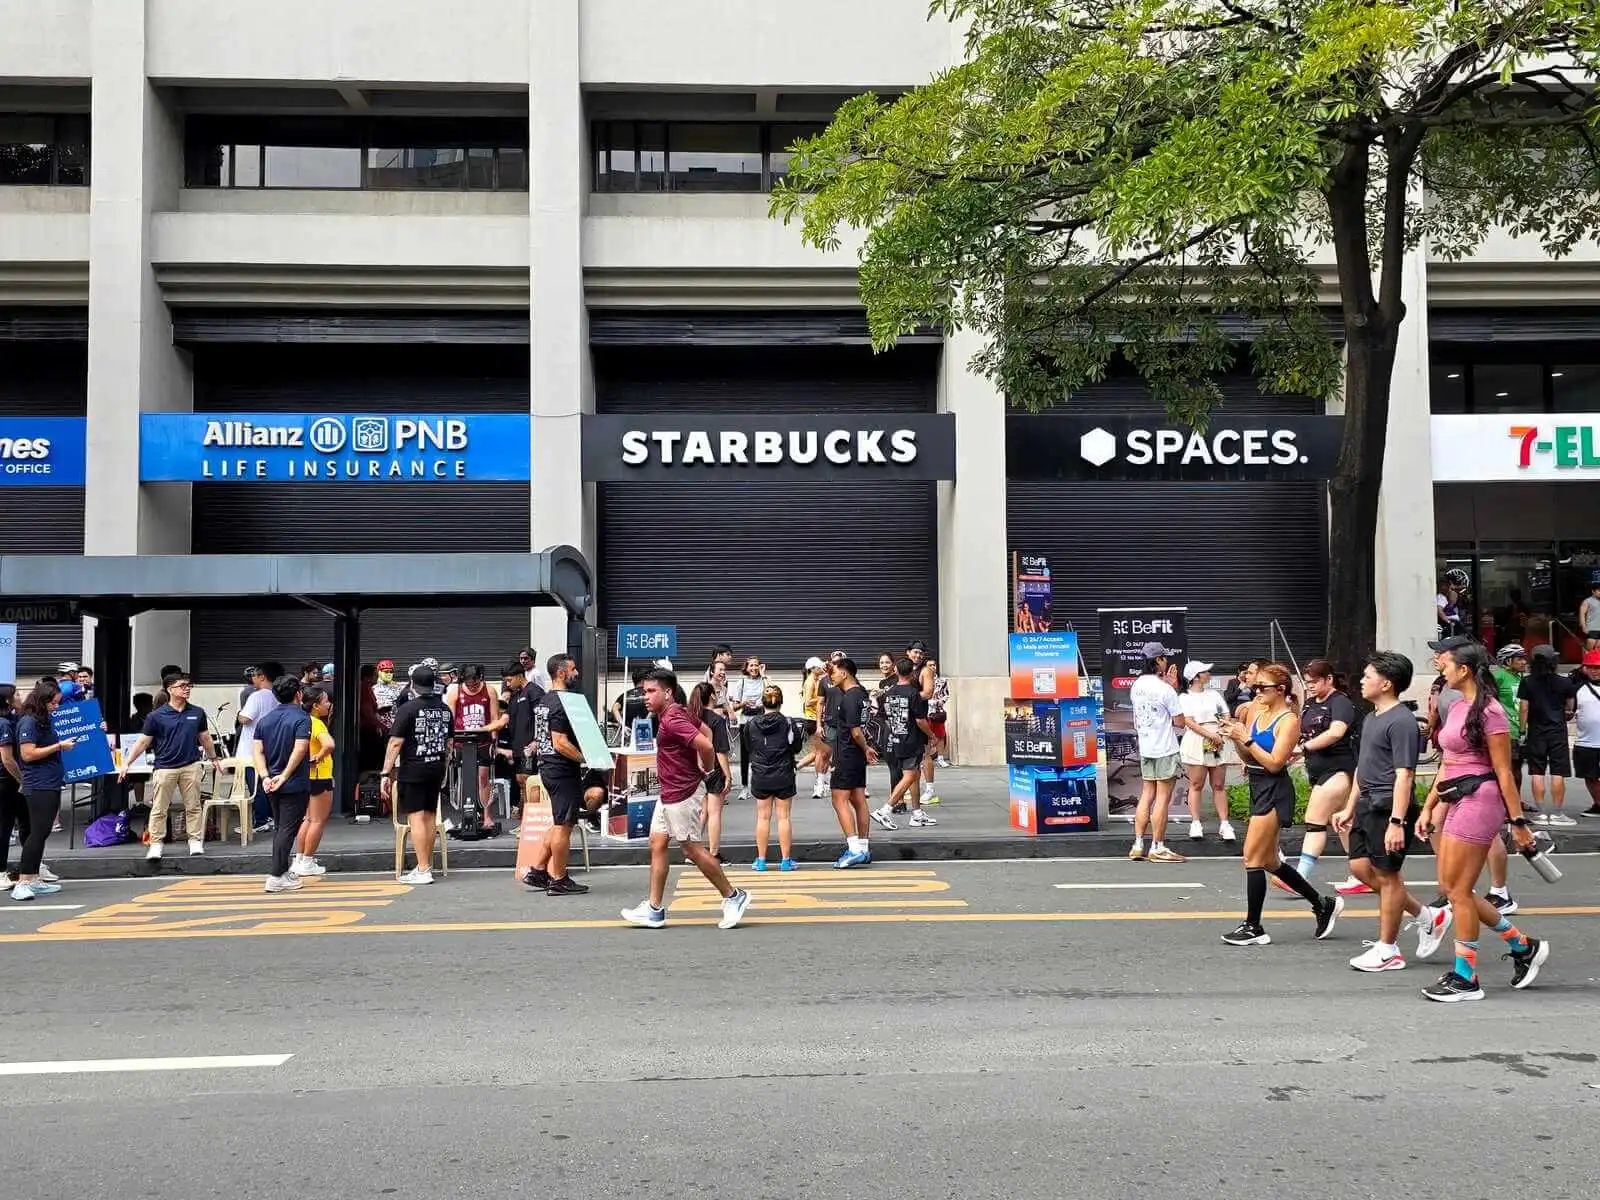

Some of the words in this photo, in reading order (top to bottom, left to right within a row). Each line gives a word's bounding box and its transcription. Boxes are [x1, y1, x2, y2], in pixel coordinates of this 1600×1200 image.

[203, 420, 304, 447] Allianz
[395, 419, 468, 450] PNB
[622, 430, 917, 464] STARBUCKS
[1126, 429, 1309, 465] SPACES.
[1508, 425, 1600, 468] 7-EL
[5, 463, 51, 474] OFFICE
[203, 460, 266, 477] LIFE
[289, 460, 465, 477] INSURANCE
[1132, 619, 1173, 634] BeFit
[640, 633, 669, 649] BeFit
[52, 707, 80, 717] Consult
[54, 719, 70, 727] with
[70, 716, 82, 724] our
[54, 722, 97, 737] Nutritionist
[1026, 740, 1053, 753] BeFit
[1061, 796, 1082, 806] BeFit
